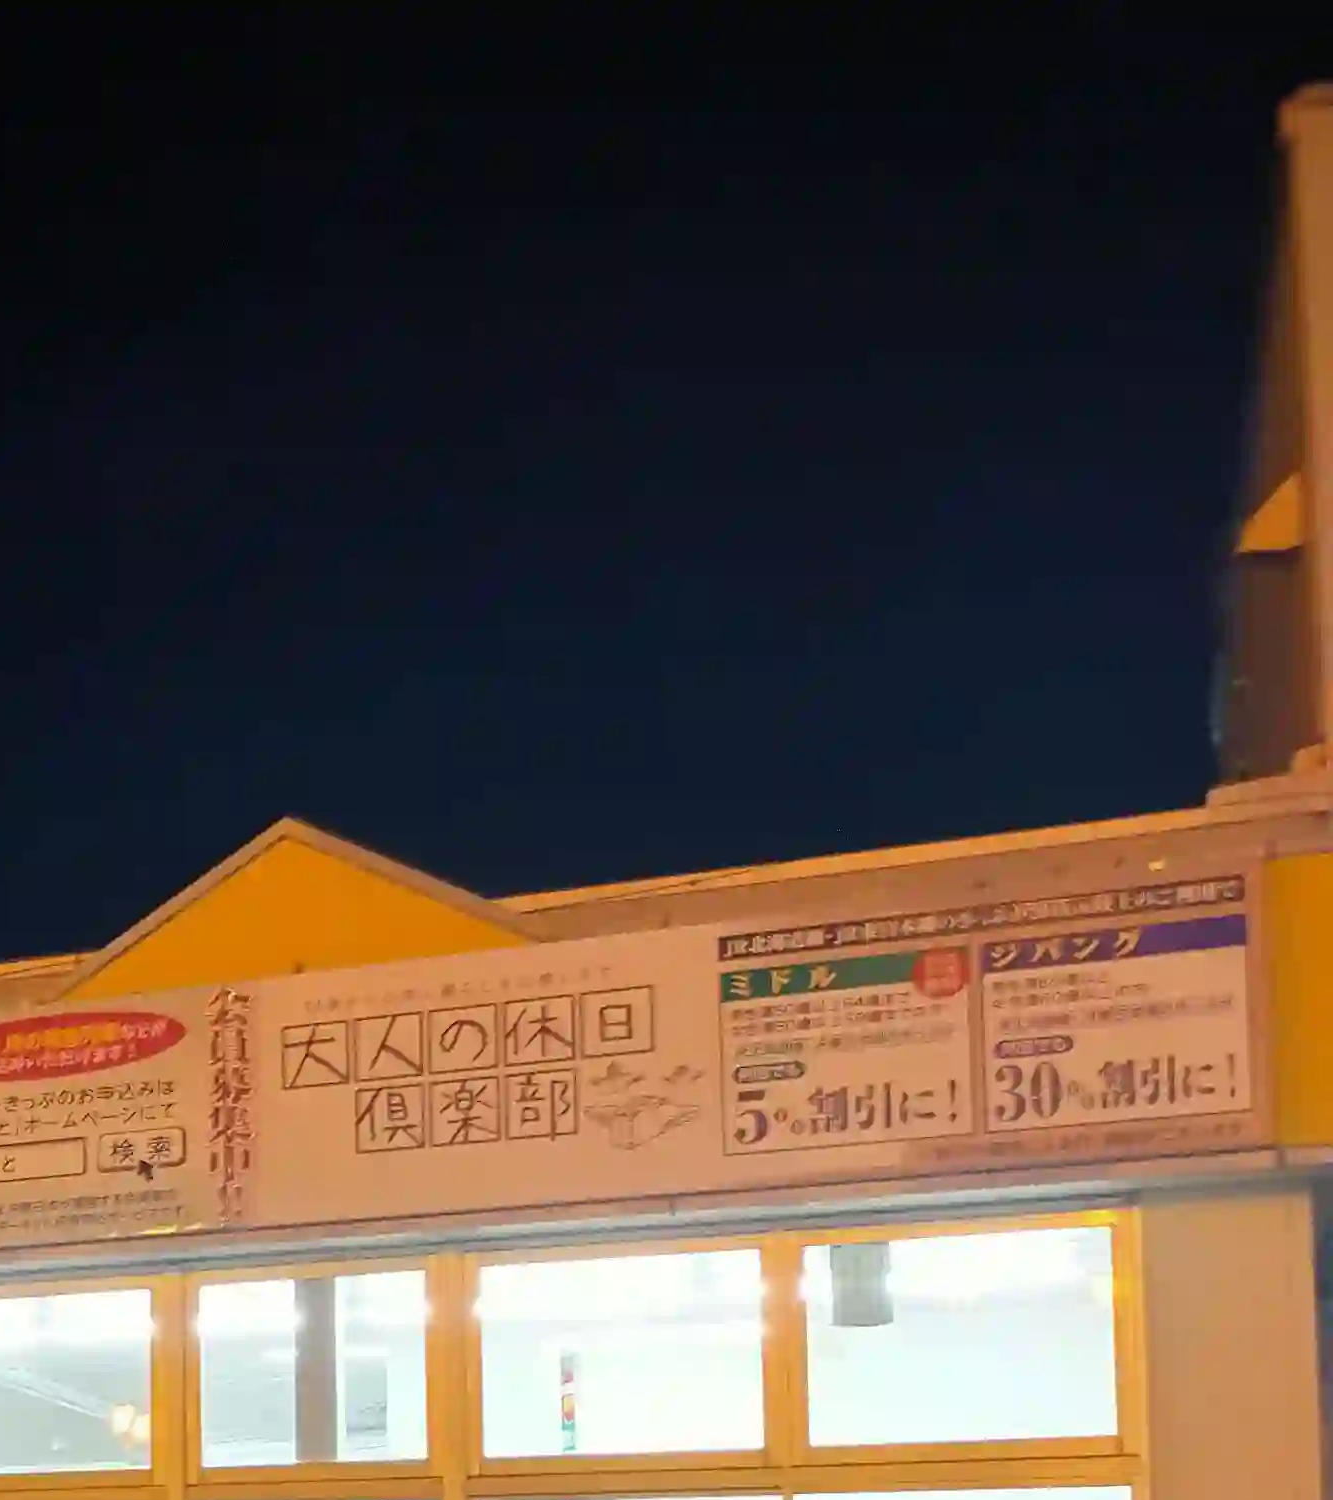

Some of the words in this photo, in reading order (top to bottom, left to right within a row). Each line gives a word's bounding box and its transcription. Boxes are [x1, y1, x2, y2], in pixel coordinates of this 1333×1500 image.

[730, 964, 837, 996] ミドル
[283, 1000, 651, 1090] 大人の休日
[355, 1078, 573, 1146] 倶楽部
[109, 1137, 172, 1165] 検索
